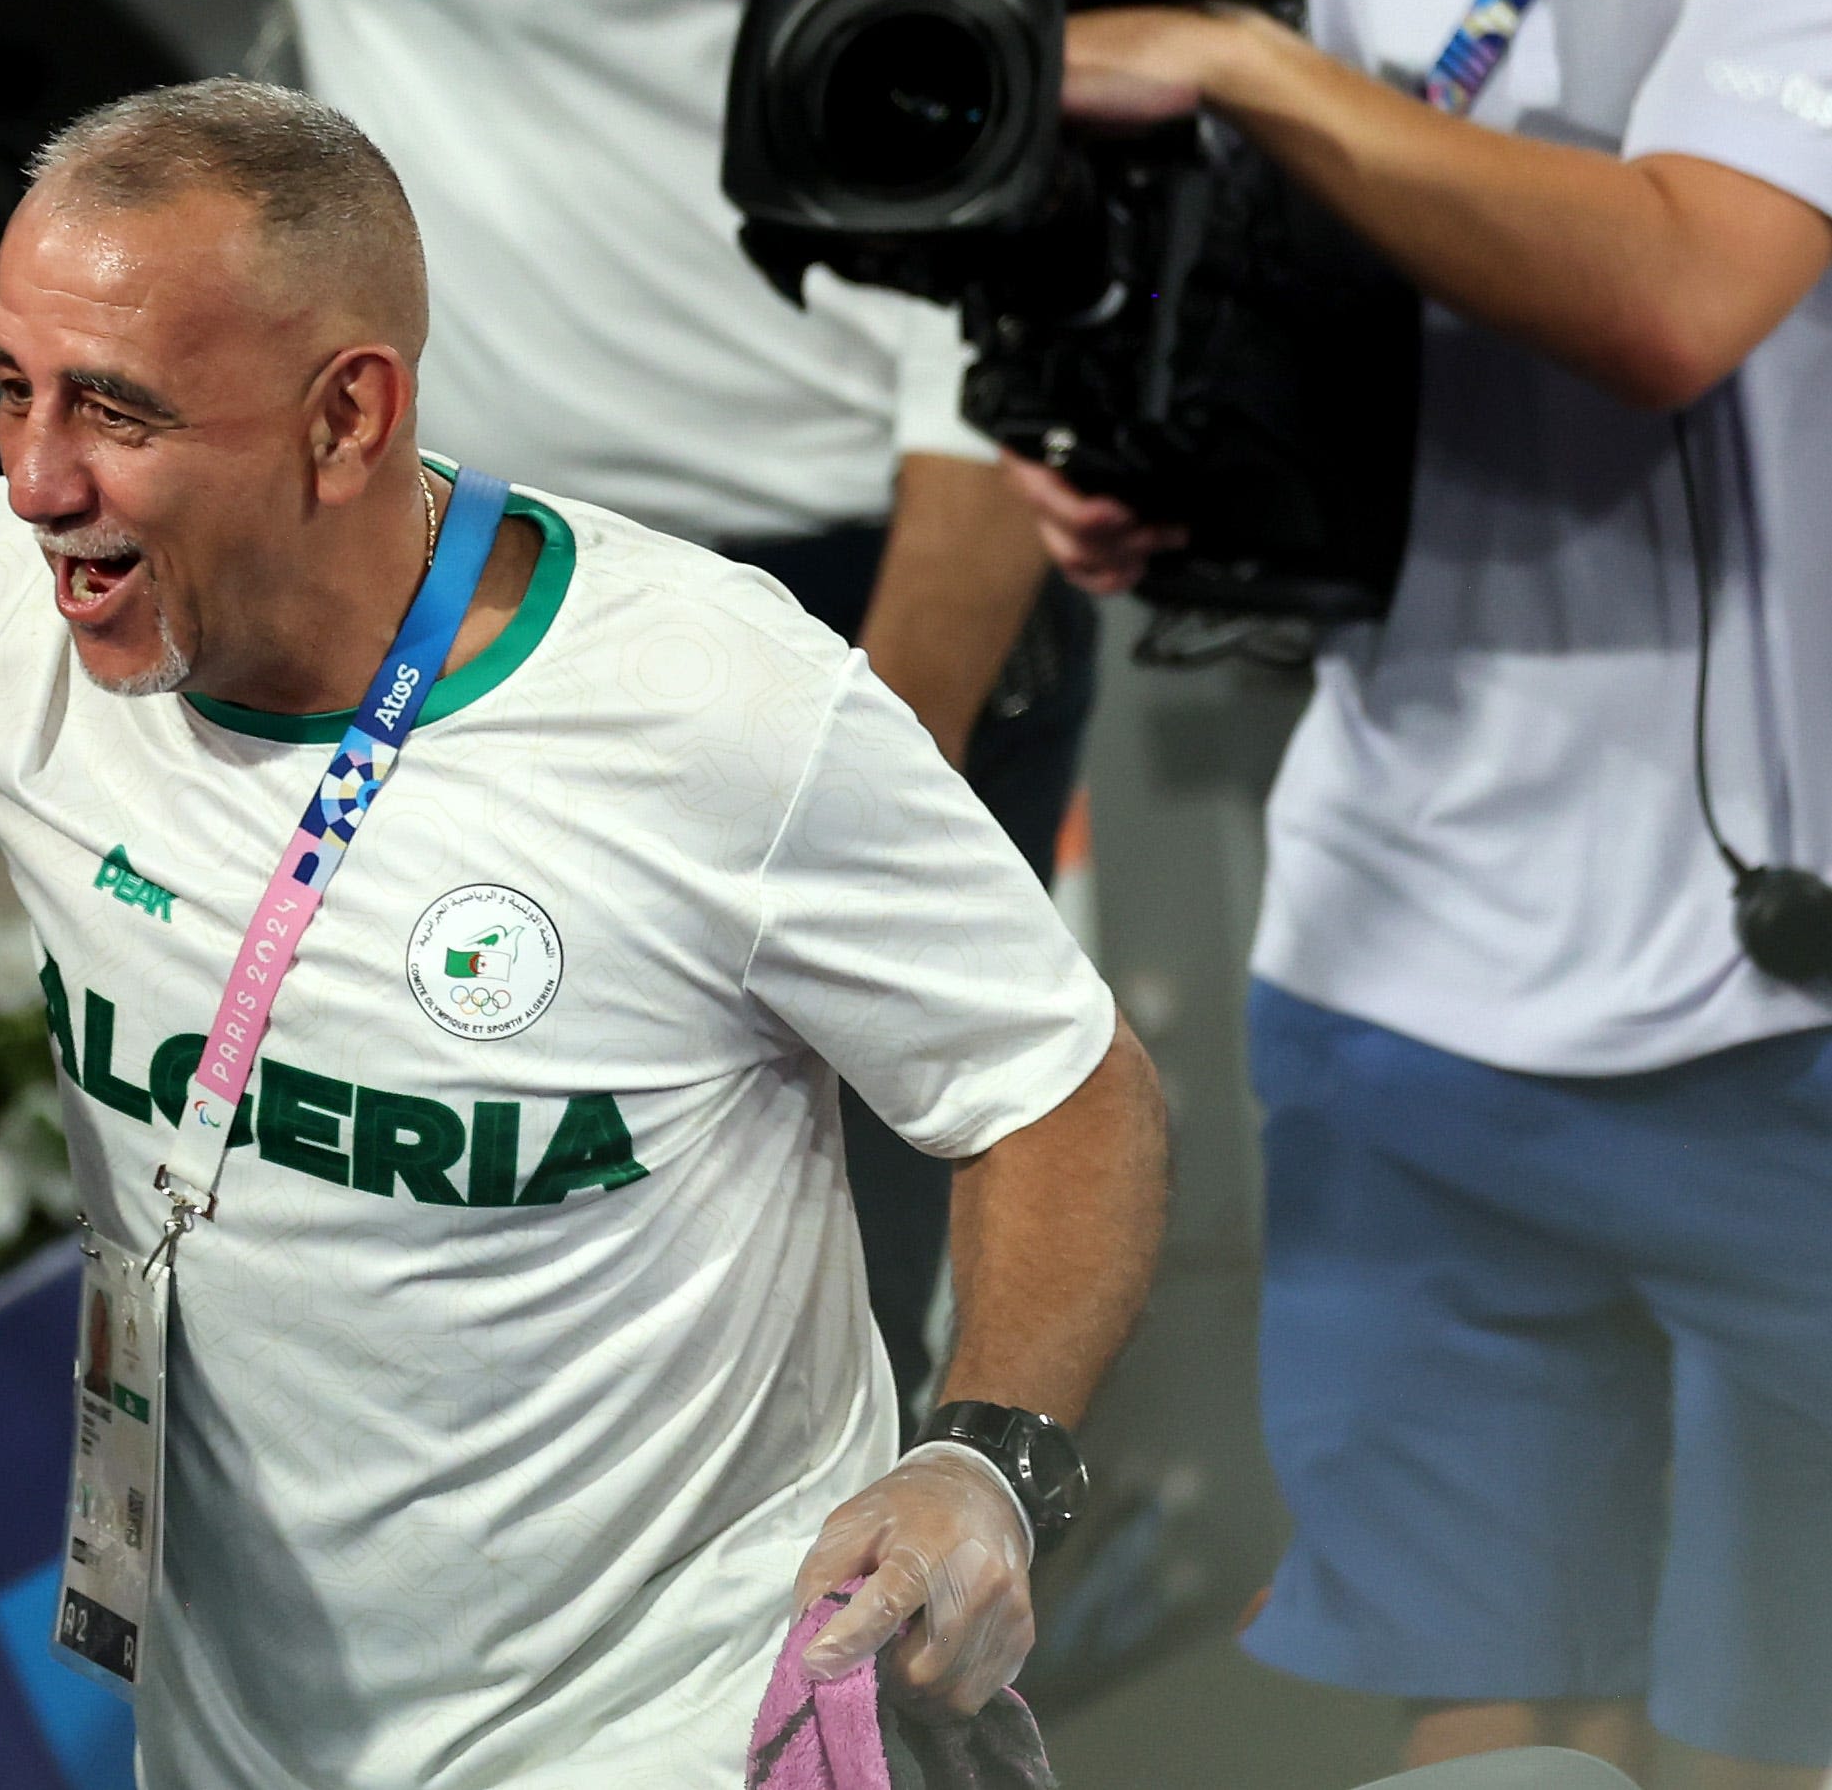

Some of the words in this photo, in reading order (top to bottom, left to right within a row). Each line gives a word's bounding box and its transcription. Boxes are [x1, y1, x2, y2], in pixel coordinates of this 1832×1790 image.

[374, 663, 420, 731] Atos
[93, 864, 175, 923] PEAK
[212, 990, 257, 1083] PARIS
[246, 898, 298, 986] 2024
[424, 996, 469, 1032] OLYMPIQUE
[472, 1025, 484, 1034] ET
[486, 1015, 524, 1034] SPORTIF
